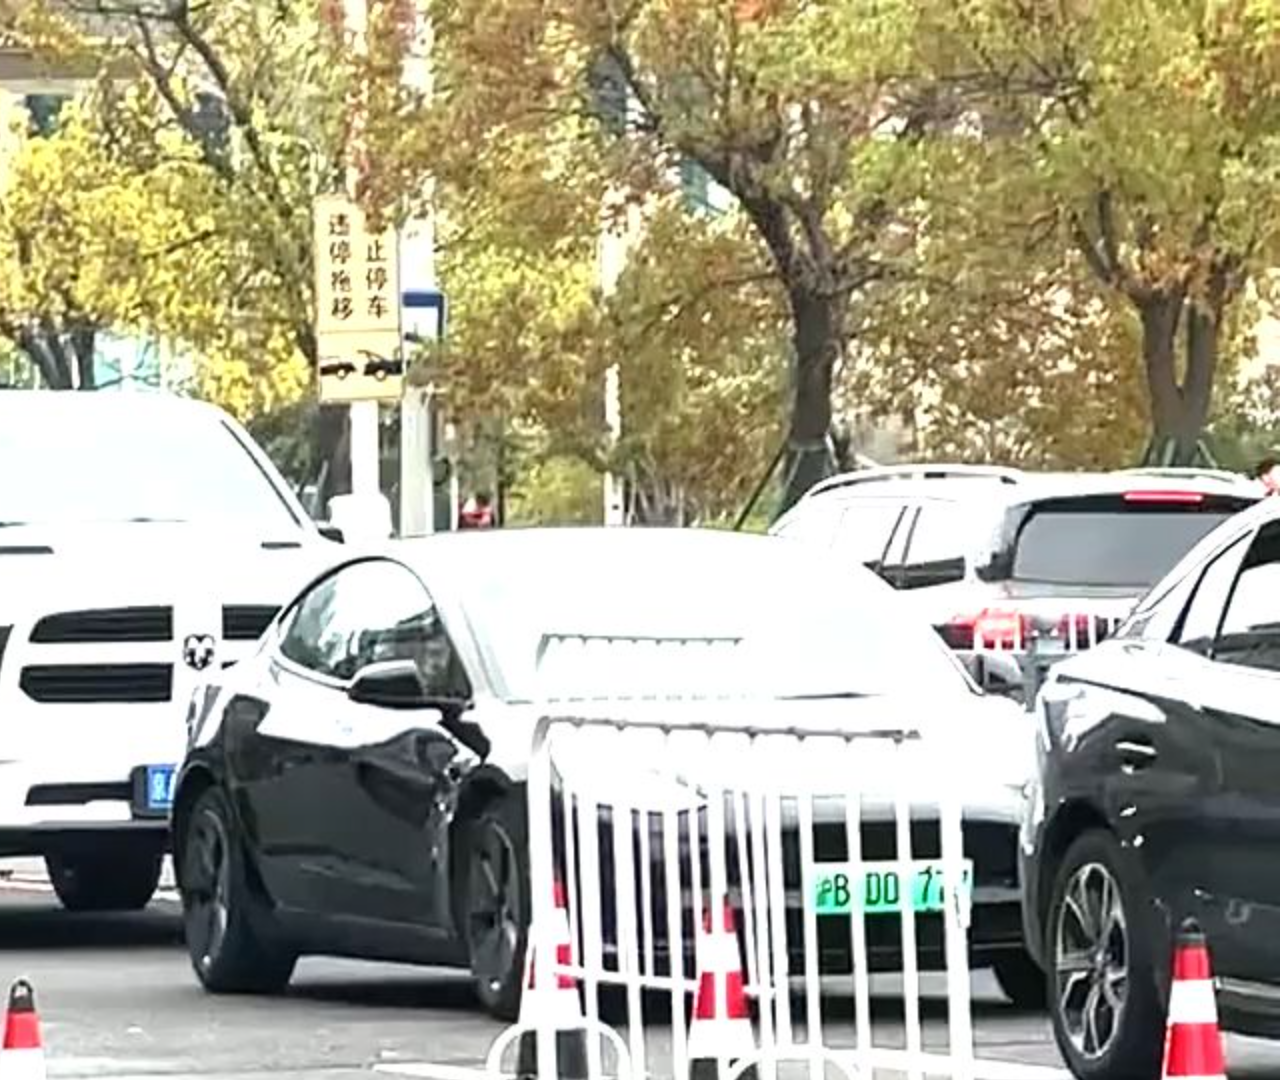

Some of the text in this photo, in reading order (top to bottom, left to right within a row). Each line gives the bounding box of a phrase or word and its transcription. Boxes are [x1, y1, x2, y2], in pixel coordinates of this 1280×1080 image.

[328, 213, 353, 320] 违停拖移
[365, 226, 389, 319] 止停车
